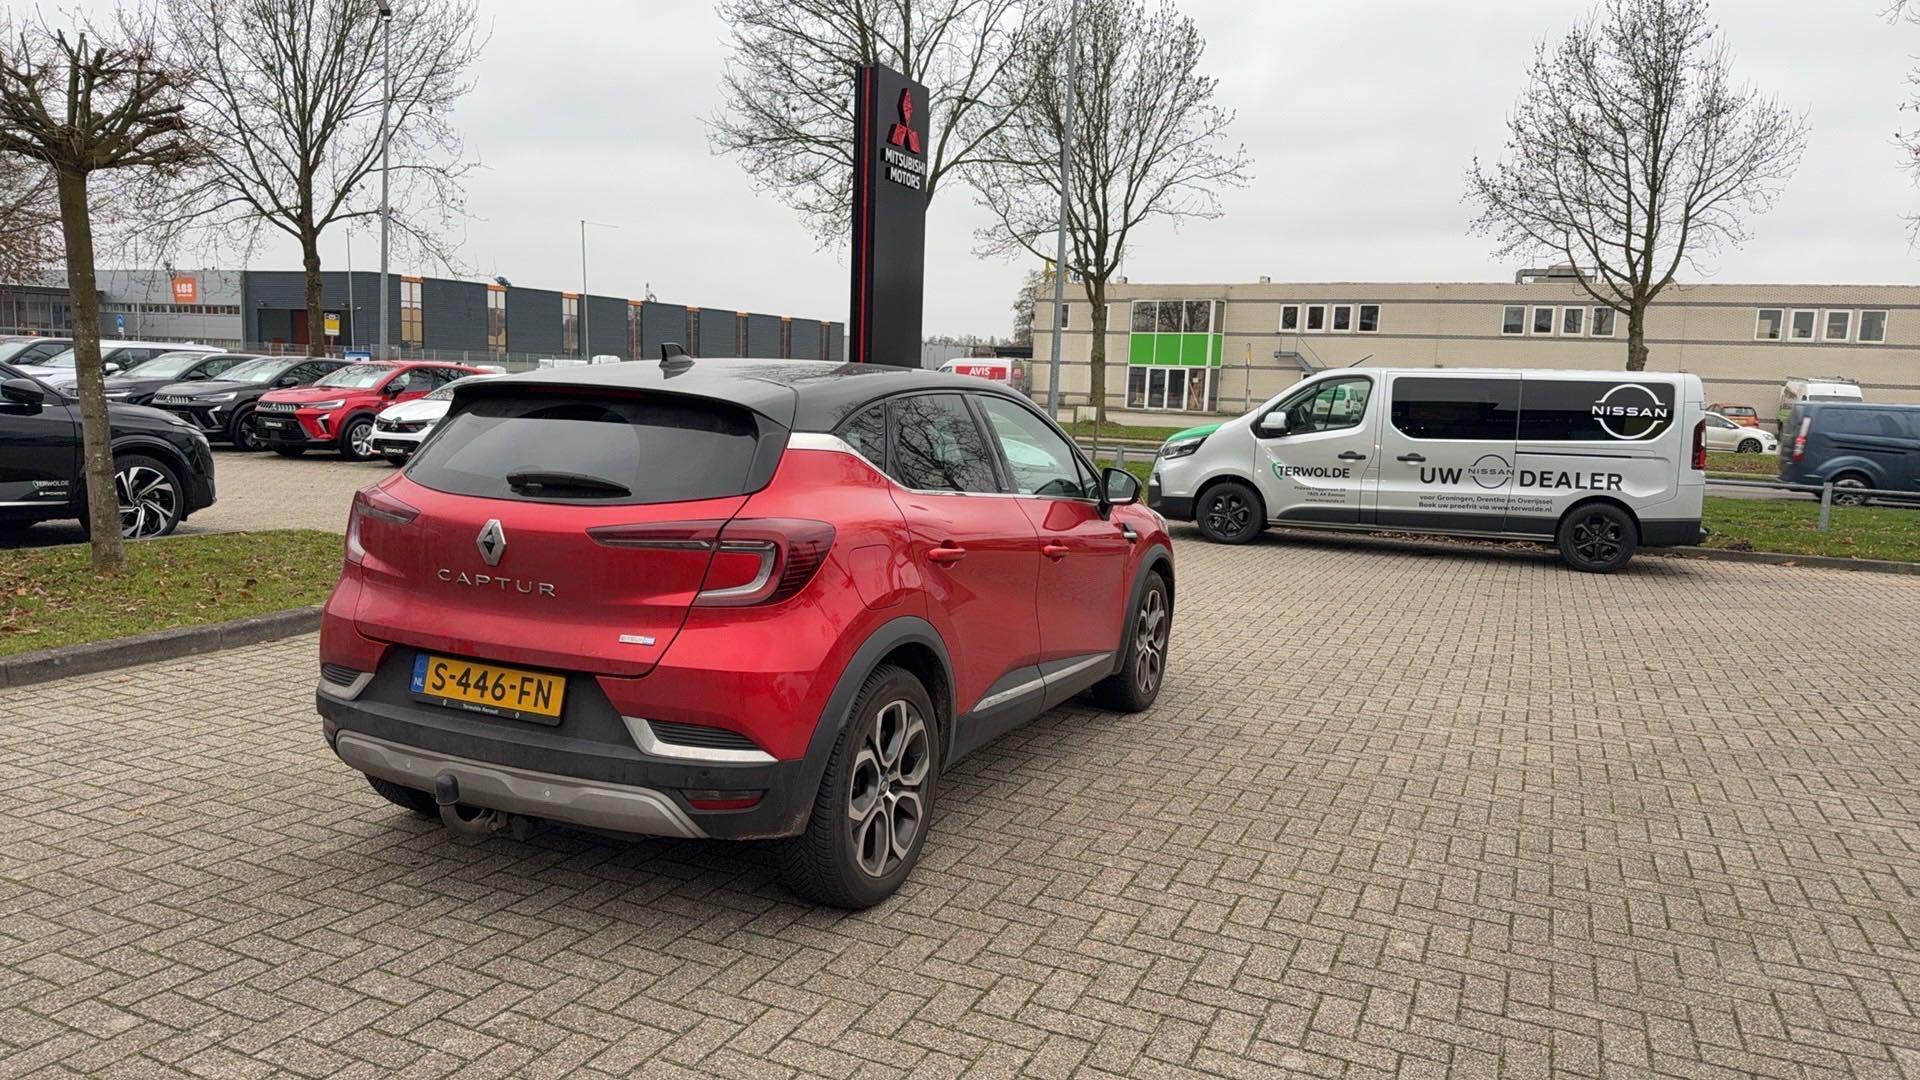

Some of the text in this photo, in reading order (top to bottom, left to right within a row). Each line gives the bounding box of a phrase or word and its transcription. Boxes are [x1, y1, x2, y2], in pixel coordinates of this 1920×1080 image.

[885, 147, 926, 176] MITSUBISHI
[890, 166, 920, 190] MOTORS
[969, 367, 991, 376] AVIS
[1591, 405, 1668, 418] NISSAN
[1277, 465, 1351, 479] TERWOLDE
[1420, 466, 1623, 492] UW NISSAN DEALER
[1517, 497, 1553, 506] Overijssel
[437, 568, 556, 597] CAPTUR
[413, 676, 424, 688] NL
[431, 662, 553, 710] S-446-FN
